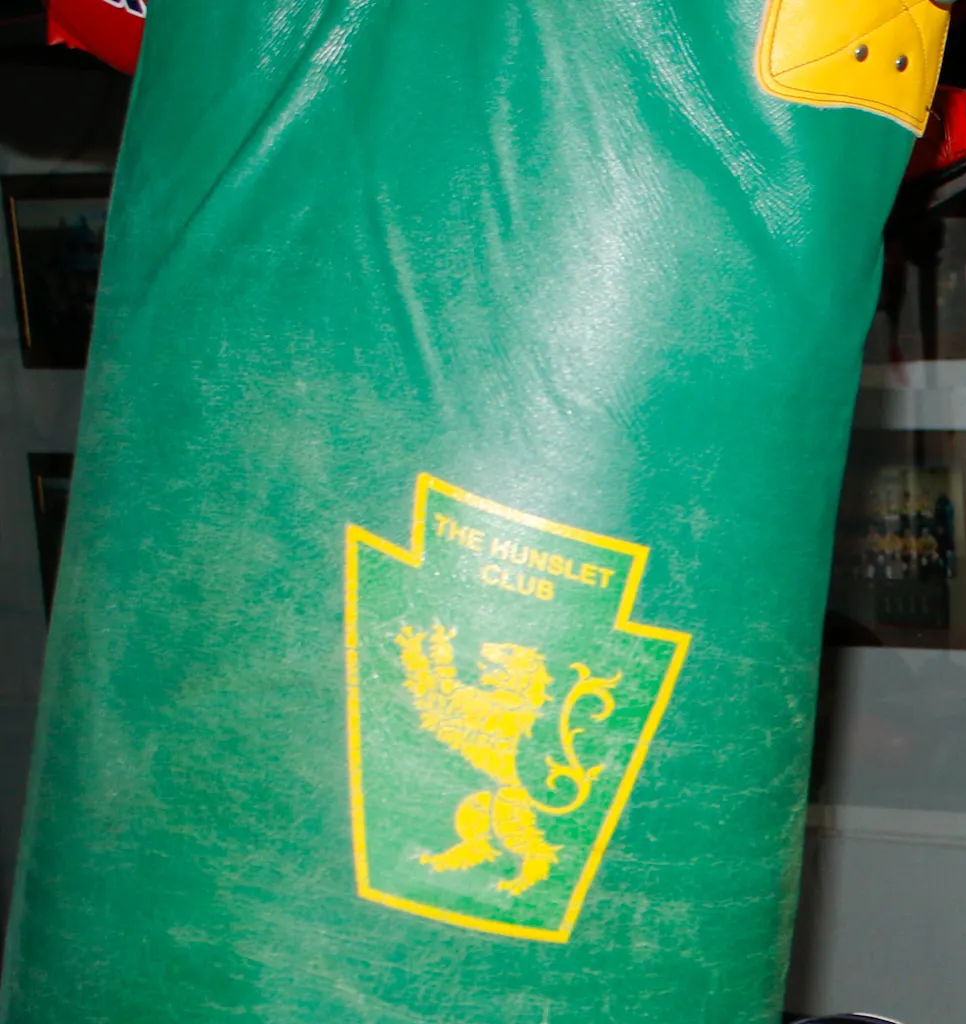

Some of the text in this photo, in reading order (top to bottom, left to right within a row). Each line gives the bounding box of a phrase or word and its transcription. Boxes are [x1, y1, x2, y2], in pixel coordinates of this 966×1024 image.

[433, 512, 616, 589] THE HUNSLET
[480, 563, 556, 601] CLUB
